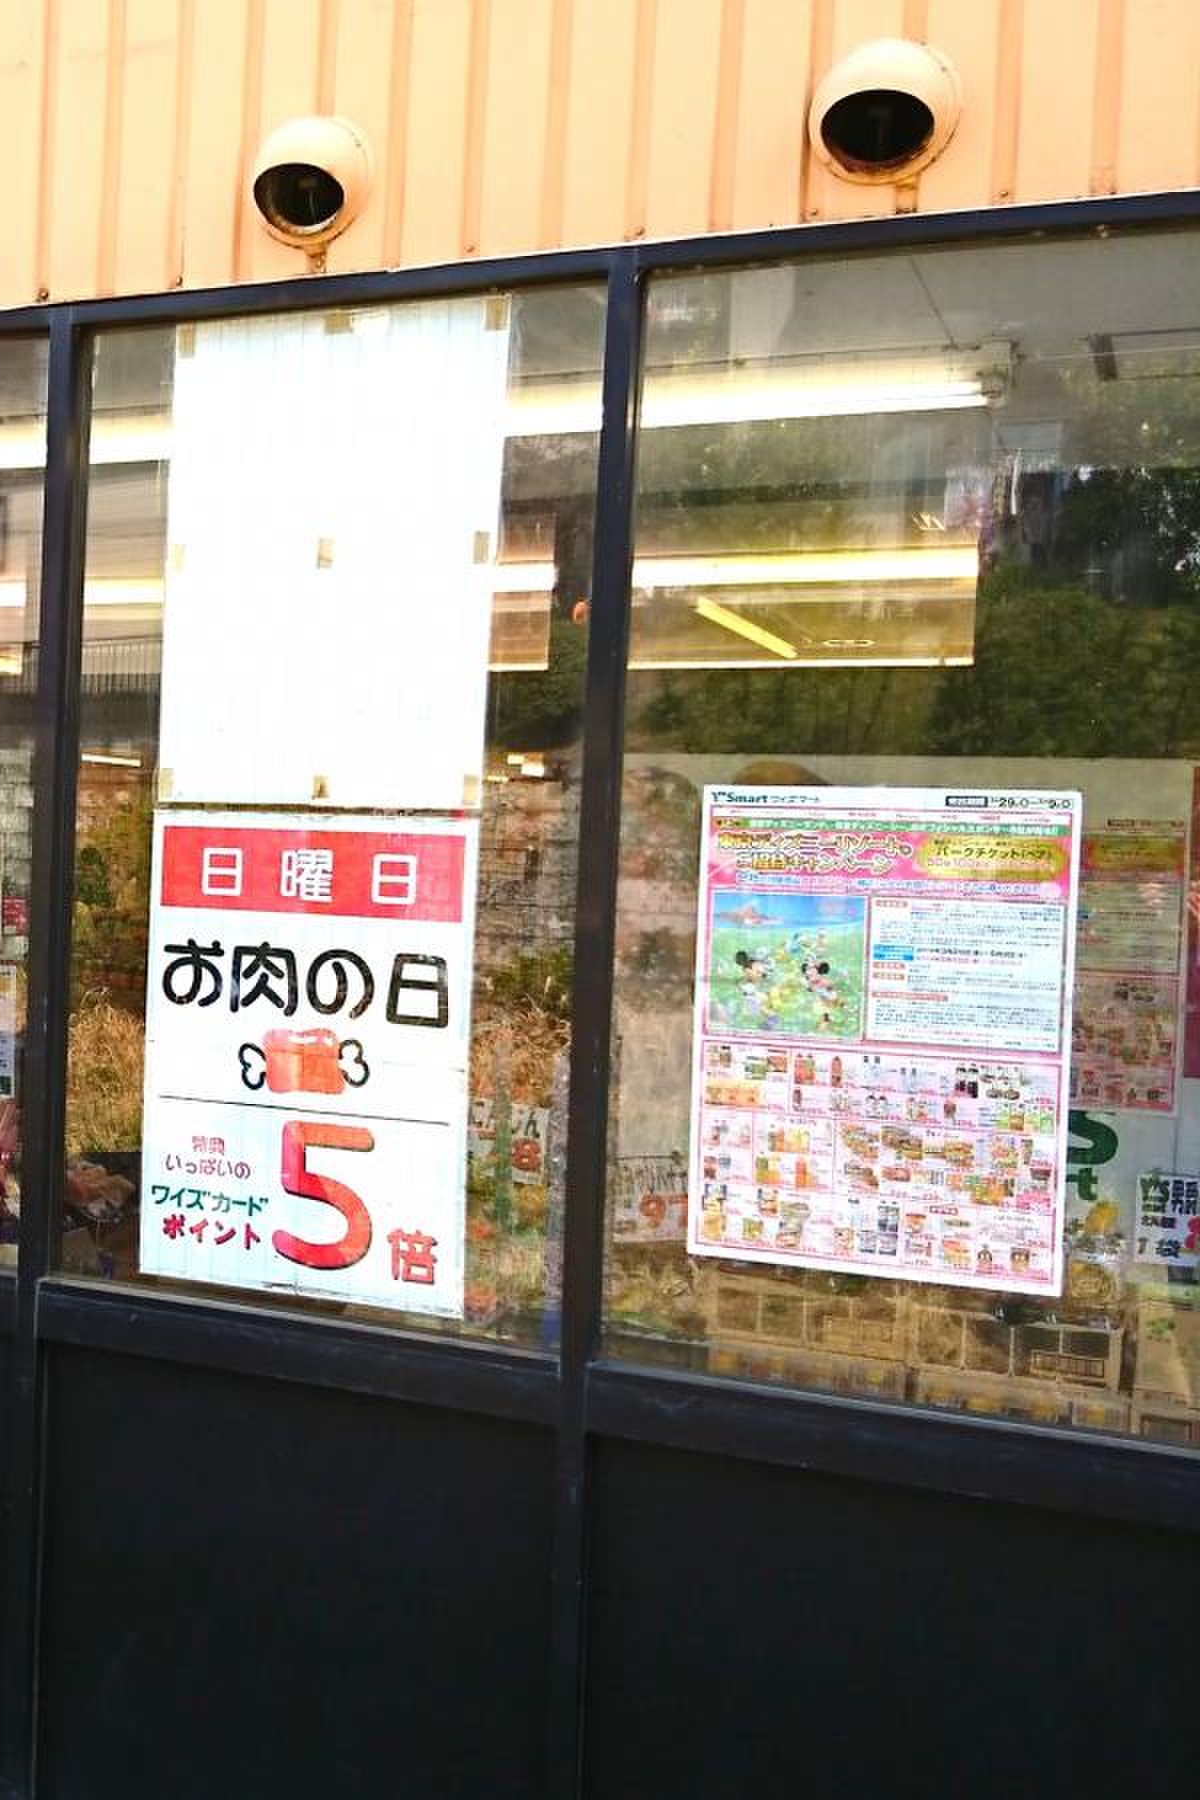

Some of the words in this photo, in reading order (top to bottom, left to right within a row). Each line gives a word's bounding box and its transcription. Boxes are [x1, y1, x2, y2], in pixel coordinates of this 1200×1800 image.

[201, 846, 419, 906] 日曜日
[161, 938, 451, 1029] お肉の日
[164, 1153, 252, 1180] いっぱいの
[150, 1184, 270, 1217] ワイズカード
[271, 1119, 377, 1272] 5
[387, 1227, 440, 1285] 倍
[162, 1213, 261, 1251] ポイント
